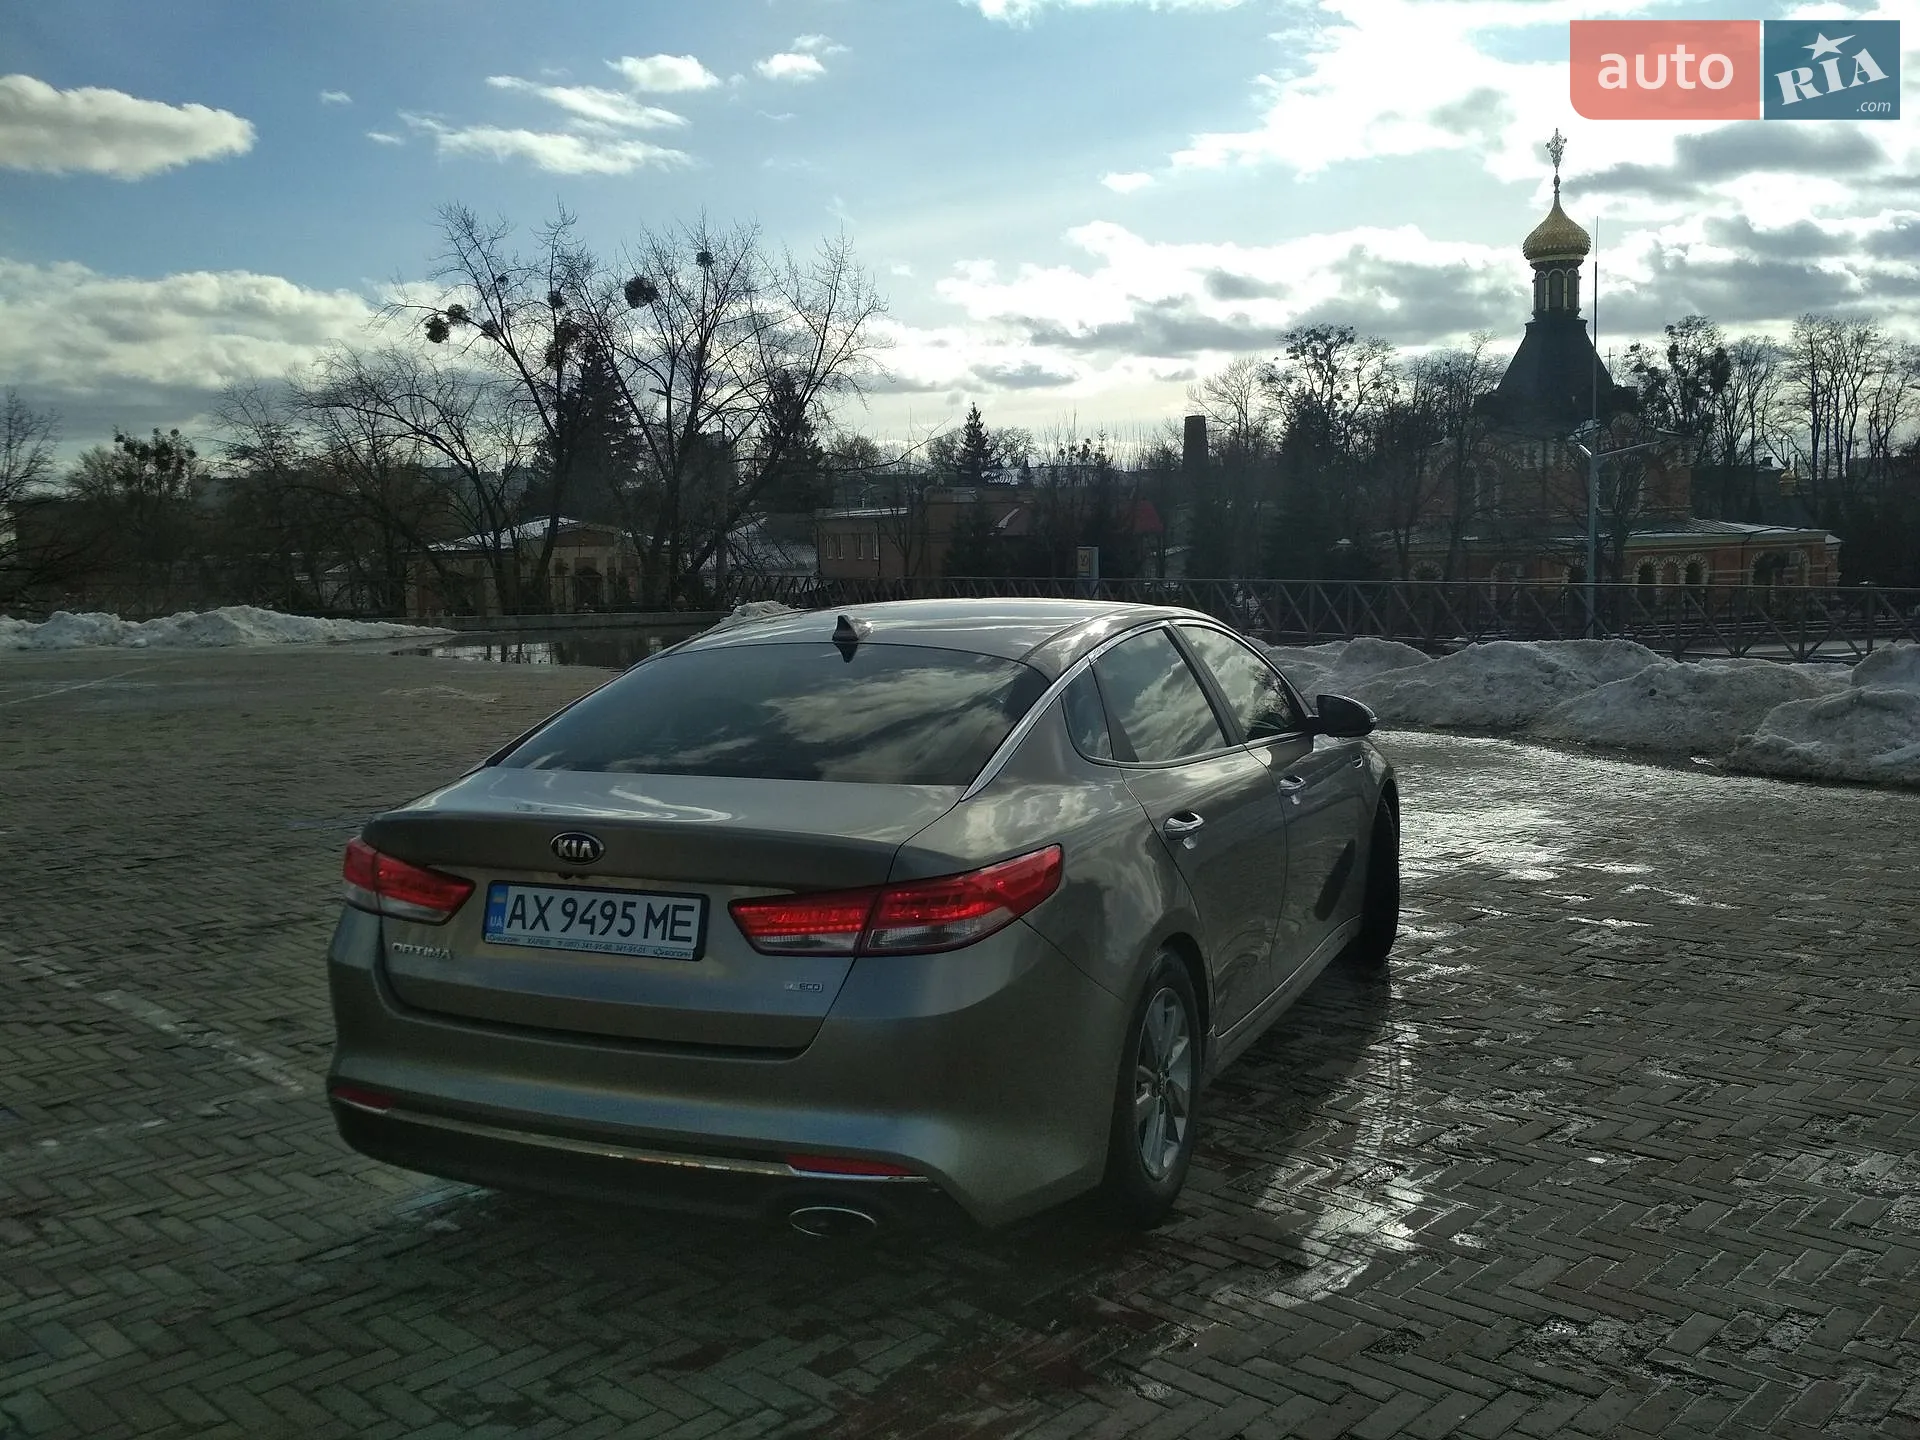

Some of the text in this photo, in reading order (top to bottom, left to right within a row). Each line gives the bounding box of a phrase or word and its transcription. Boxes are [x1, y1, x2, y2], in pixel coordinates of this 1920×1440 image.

[557, 839, 594, 858] KIA
[490, 915, 504, 928] UA
[506, 894, 696, 943] AX 9495 ME
